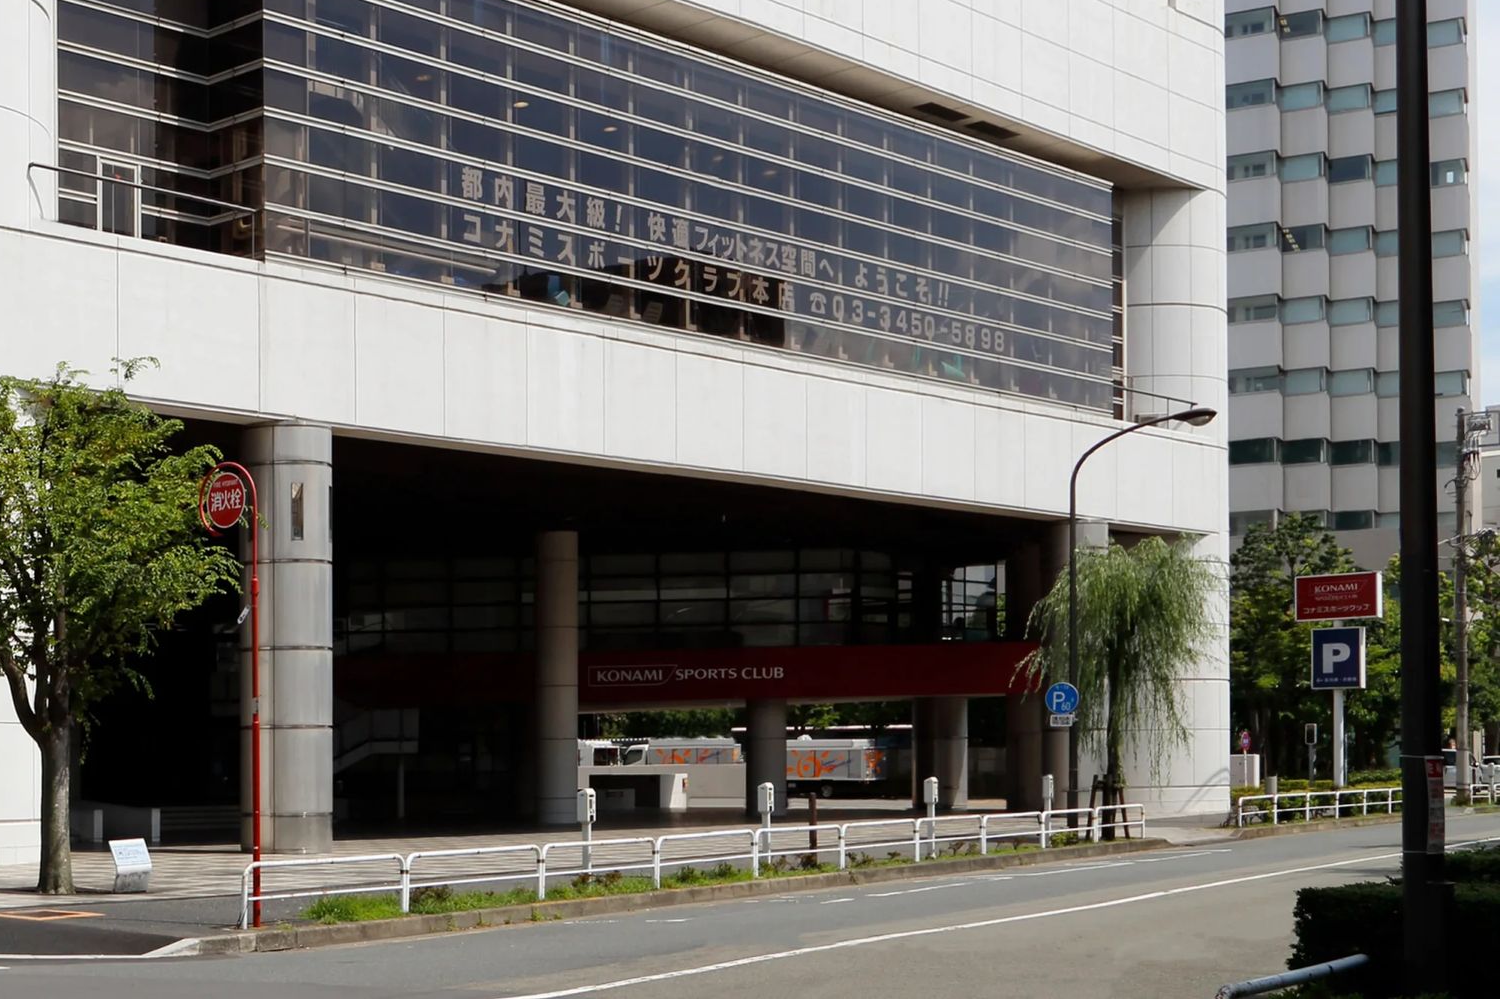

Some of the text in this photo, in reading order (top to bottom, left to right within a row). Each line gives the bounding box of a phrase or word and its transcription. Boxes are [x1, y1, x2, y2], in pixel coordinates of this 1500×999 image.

[210, 488, 242, 512] 消火栓
[1314, 583, 1358, 594] KONAMI
[1322, 642, 1351, 674] P
[596, 666, 784, 683] KONAMI SPORTS CLUB
